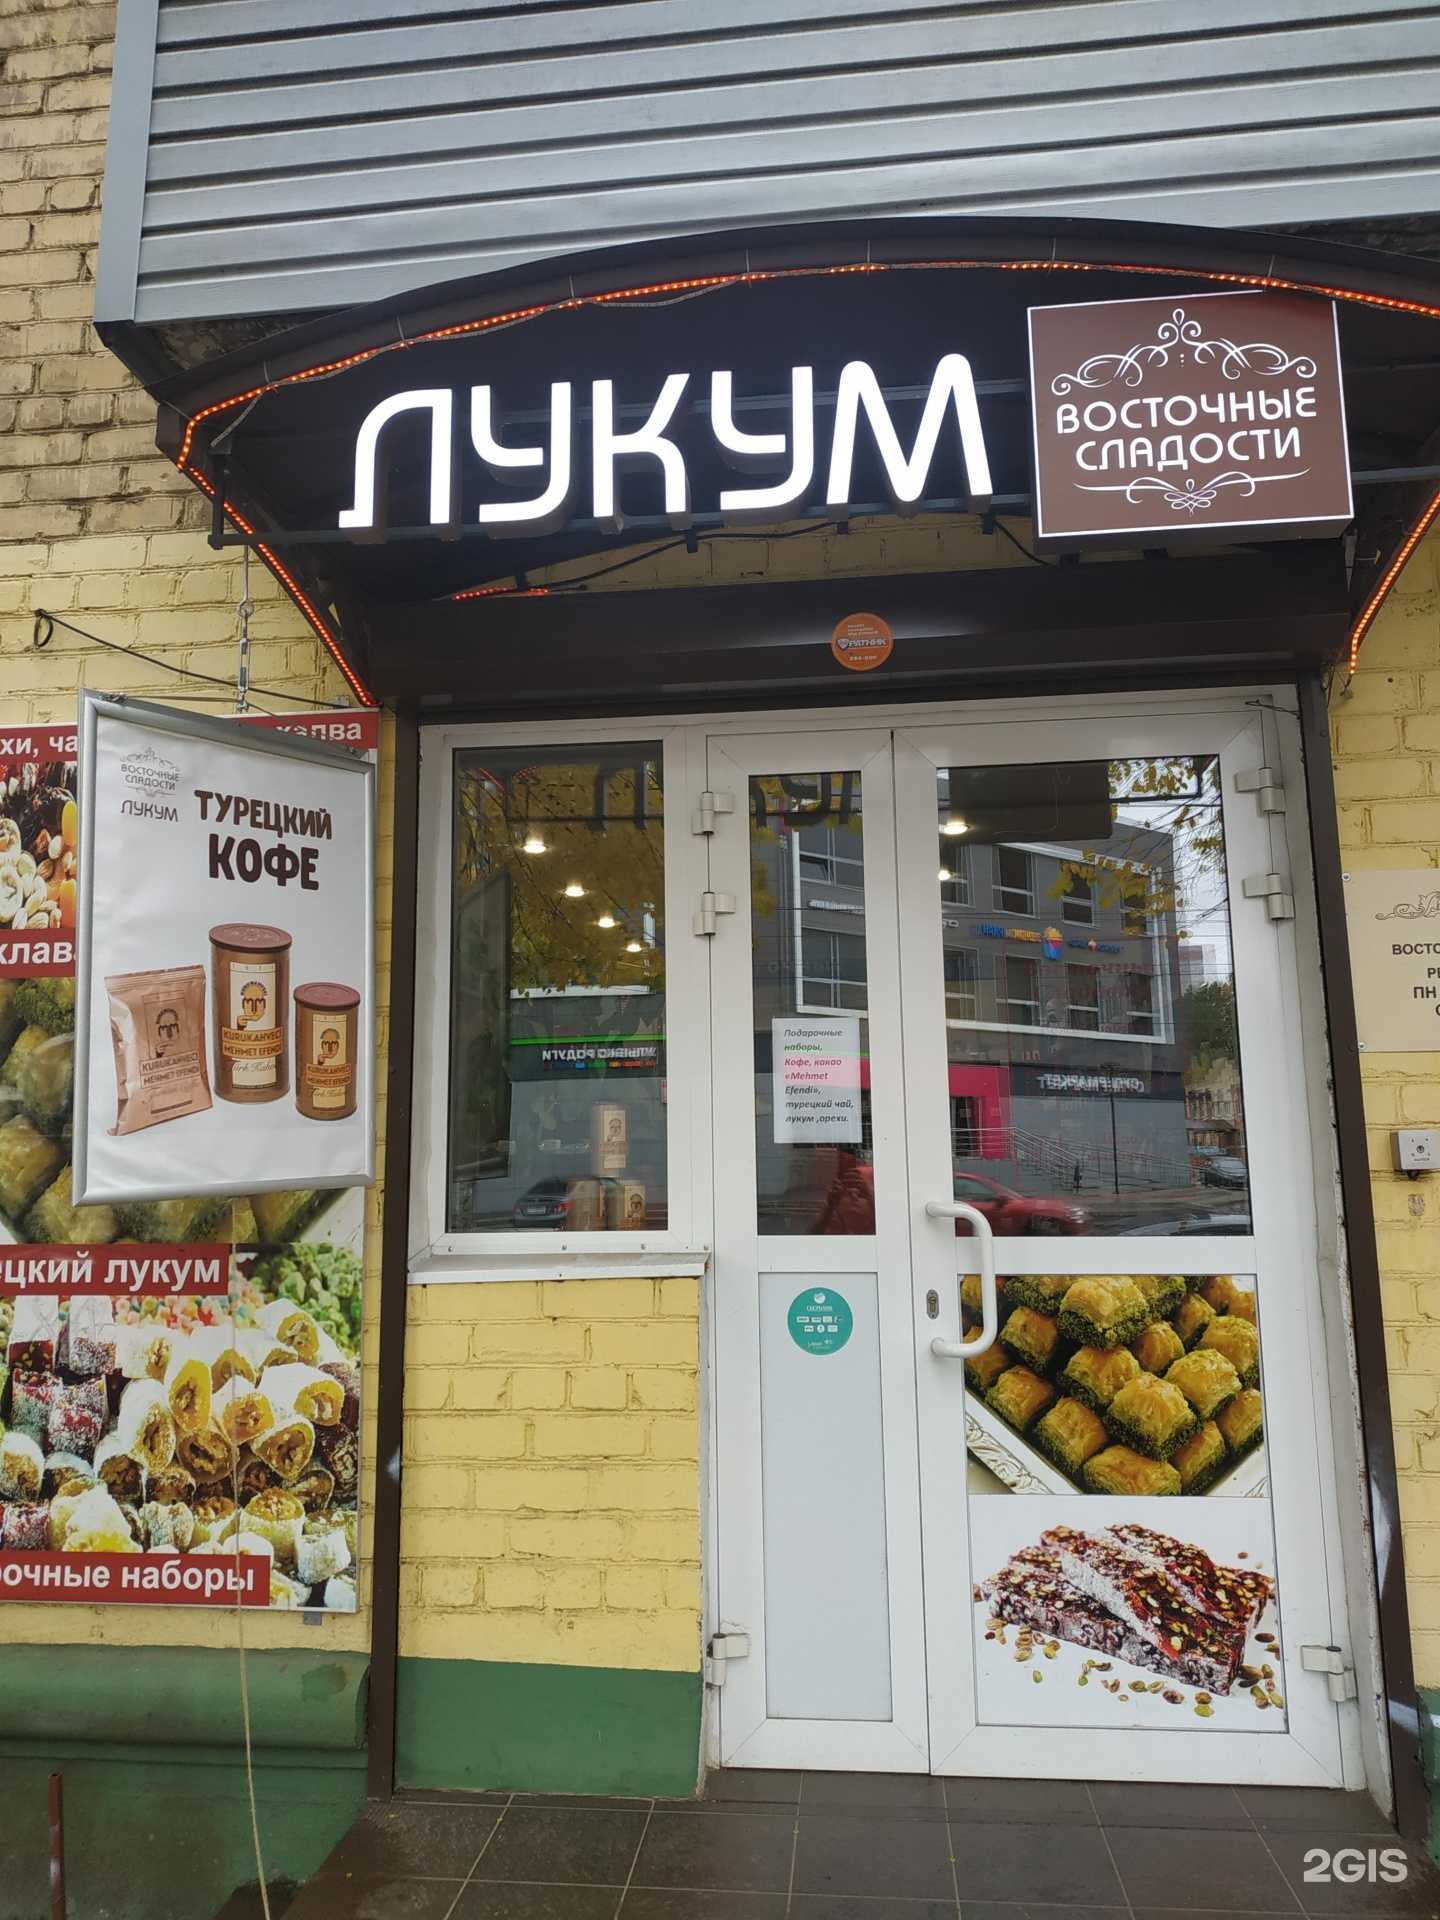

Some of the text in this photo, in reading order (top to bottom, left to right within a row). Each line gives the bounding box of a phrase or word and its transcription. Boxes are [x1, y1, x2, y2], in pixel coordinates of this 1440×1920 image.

[1056, 386, 1317, 434] ВОСТОЧНЫЕ
[338, 353, 993, 529] ЛУКУМ
[1075, 426, 1301, 472] СЛАДОСТИ
[120, 763, 181, 782] ВОСТОЧНЫЕ
[125, 774, 176, 791] СЛАДОСТИ
[121, 799, 178, 823] ЛУКУМ
[194, 789, 333, 840] ТУРЕЦКИЙ
[208, 833, 319, 891] КОФЕ
[1413, 986, 1437, 999] ПН
[784, 1028, 843, 1038] Подарочные
[784, 1043, 823, 1053] наборы,
[784, 1058, 842, 1068] Кофе, какао
[785, 1072, 829, 1081] «Mehmet
[785, 1099, 855, 1111] турецкий чай,
[785, 1114, 815, 1124] лукум
[0, 1250, 220, 1292] цкий лукум
[0, 1559, 254, 1598] очные наборы
